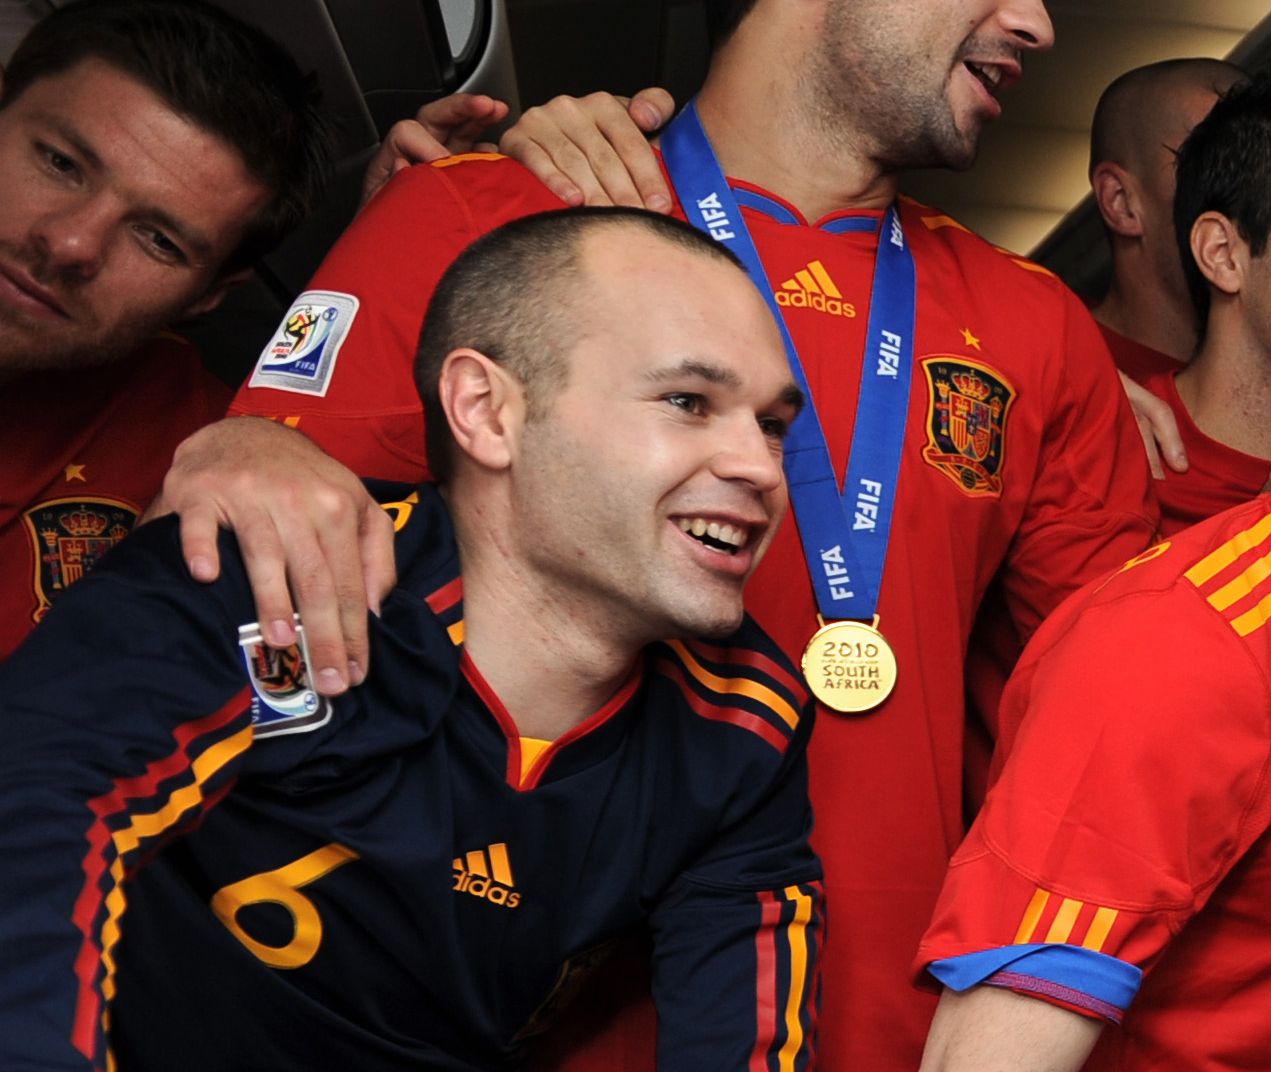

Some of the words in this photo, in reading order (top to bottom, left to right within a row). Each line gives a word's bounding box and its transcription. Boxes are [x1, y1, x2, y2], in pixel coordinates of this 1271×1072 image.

[698, 192, 735, 241] FIFA
[890, 208, 904, 248] IFA
[774, 289, 857, 318] adidas
[877, 329, 901, 377] FIFA
[853, 478, 882, 531] FIFA
[821, 545, 854, 601] FIFA
[822, 664, 880, 678] SOUTH
[823, 641, 878, 658] 2010
[211, 842, 361, 970] 6
[452, 870, 521, 908] didas
